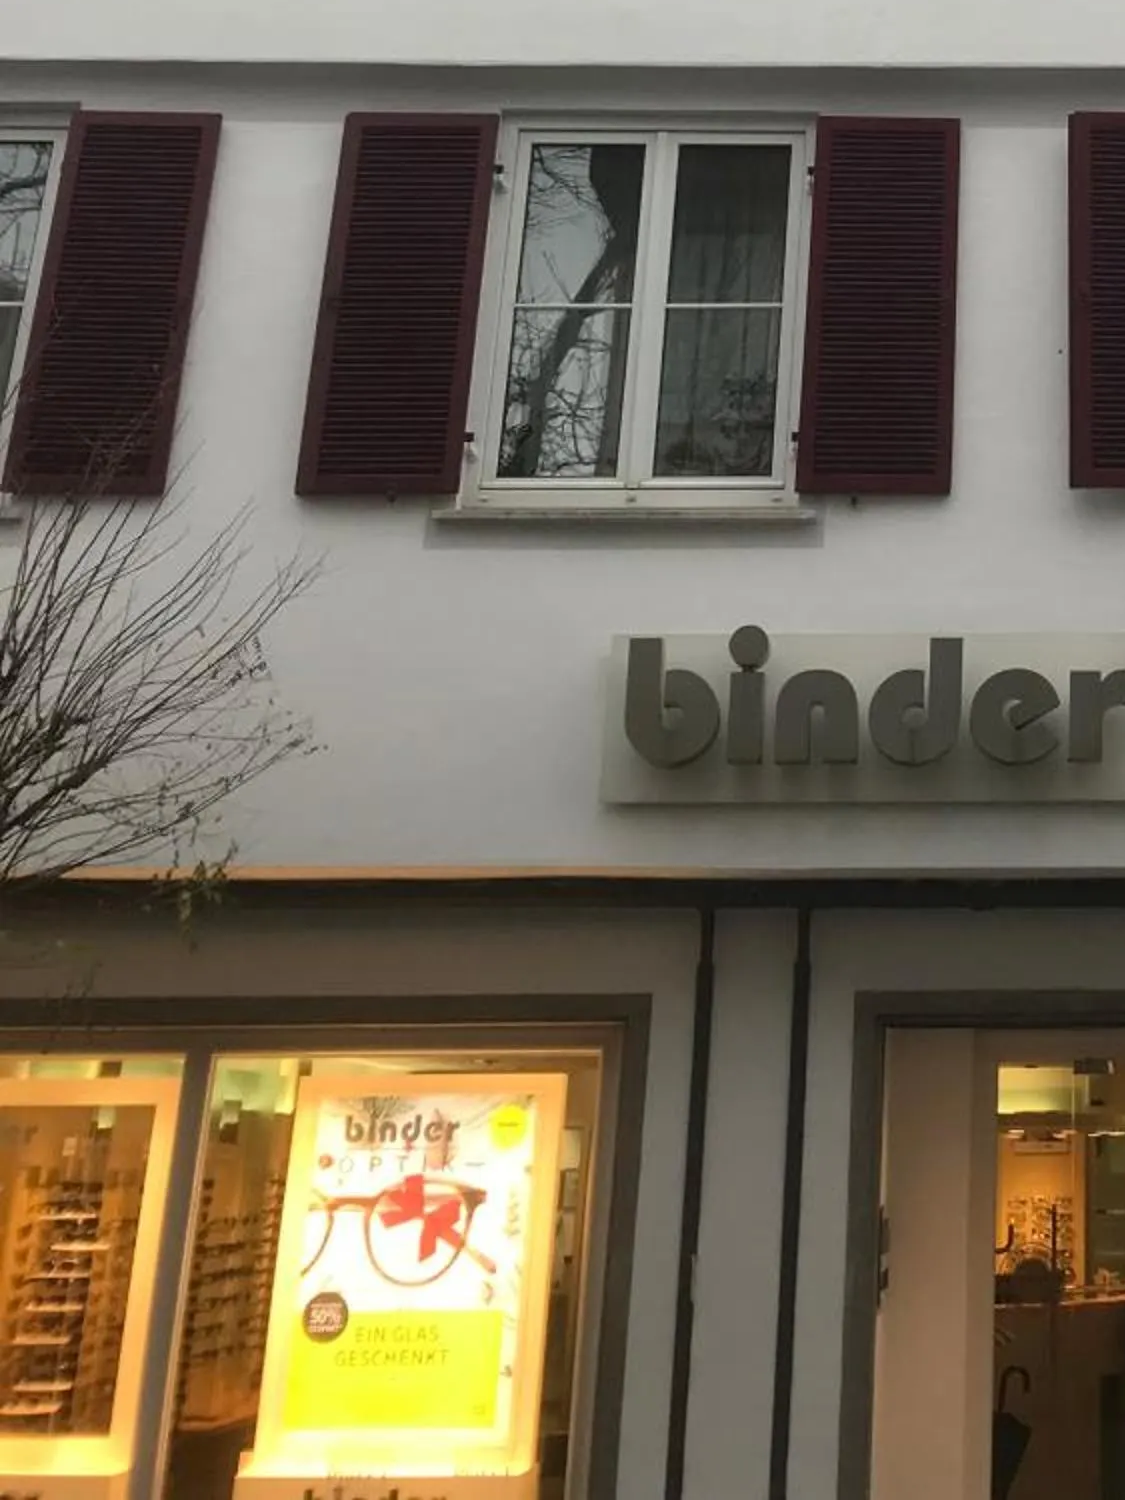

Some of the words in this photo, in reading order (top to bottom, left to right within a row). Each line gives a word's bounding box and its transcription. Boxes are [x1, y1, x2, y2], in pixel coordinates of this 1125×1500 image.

[344, 1111, 460, 1143] binder
[355, 1327, 386, 1343] EIN
[393, 1325, 440, 1343] GLAS
[334, 1349, 450, 1368] GESCHENKT
